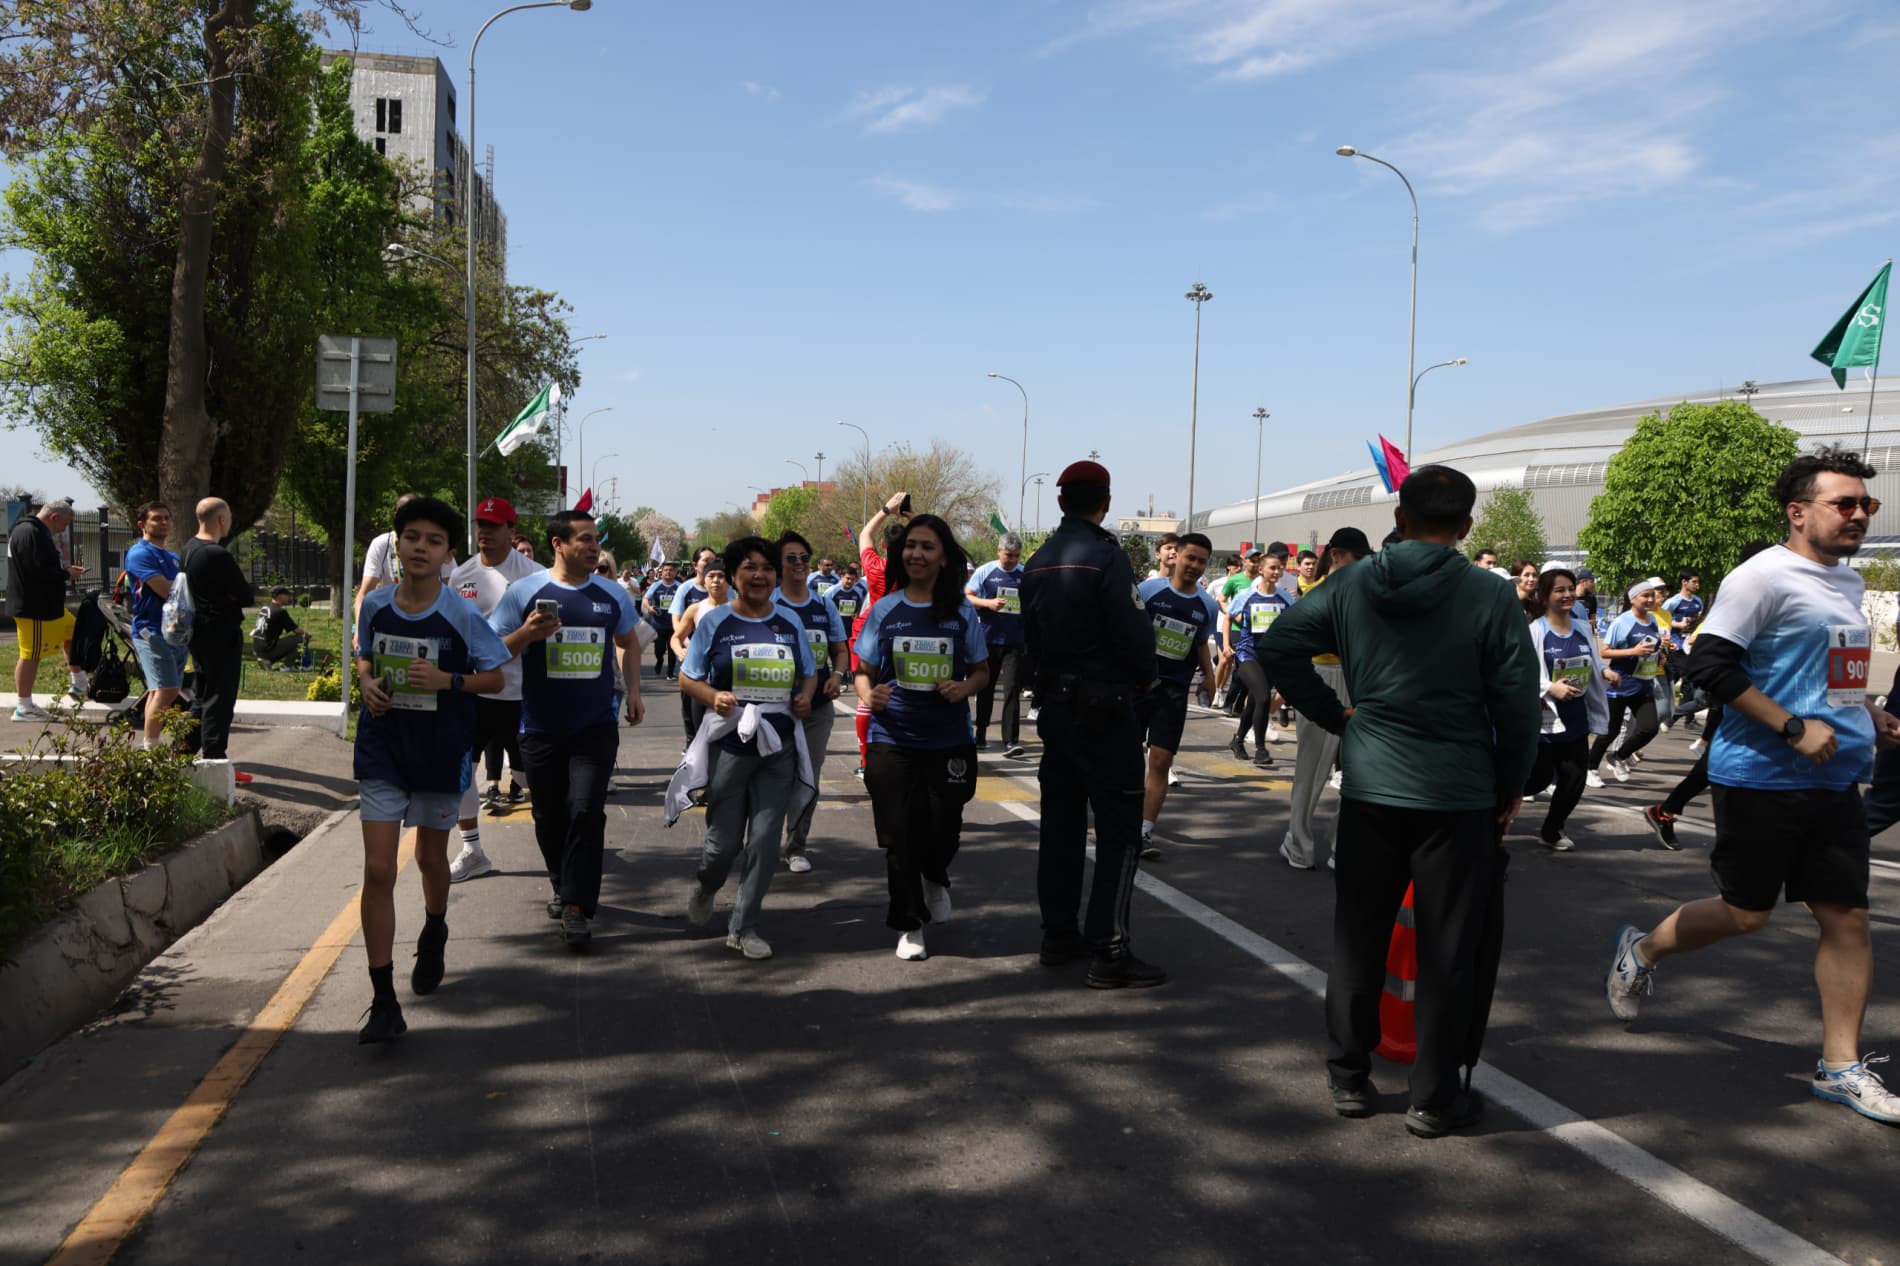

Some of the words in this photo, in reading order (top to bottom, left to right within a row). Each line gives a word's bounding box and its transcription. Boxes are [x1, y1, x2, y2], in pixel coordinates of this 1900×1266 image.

[562, 652, 601, 666] 5006
[750, 667, 791, 681] 5008
[908, 661, 949, 678] 5010
